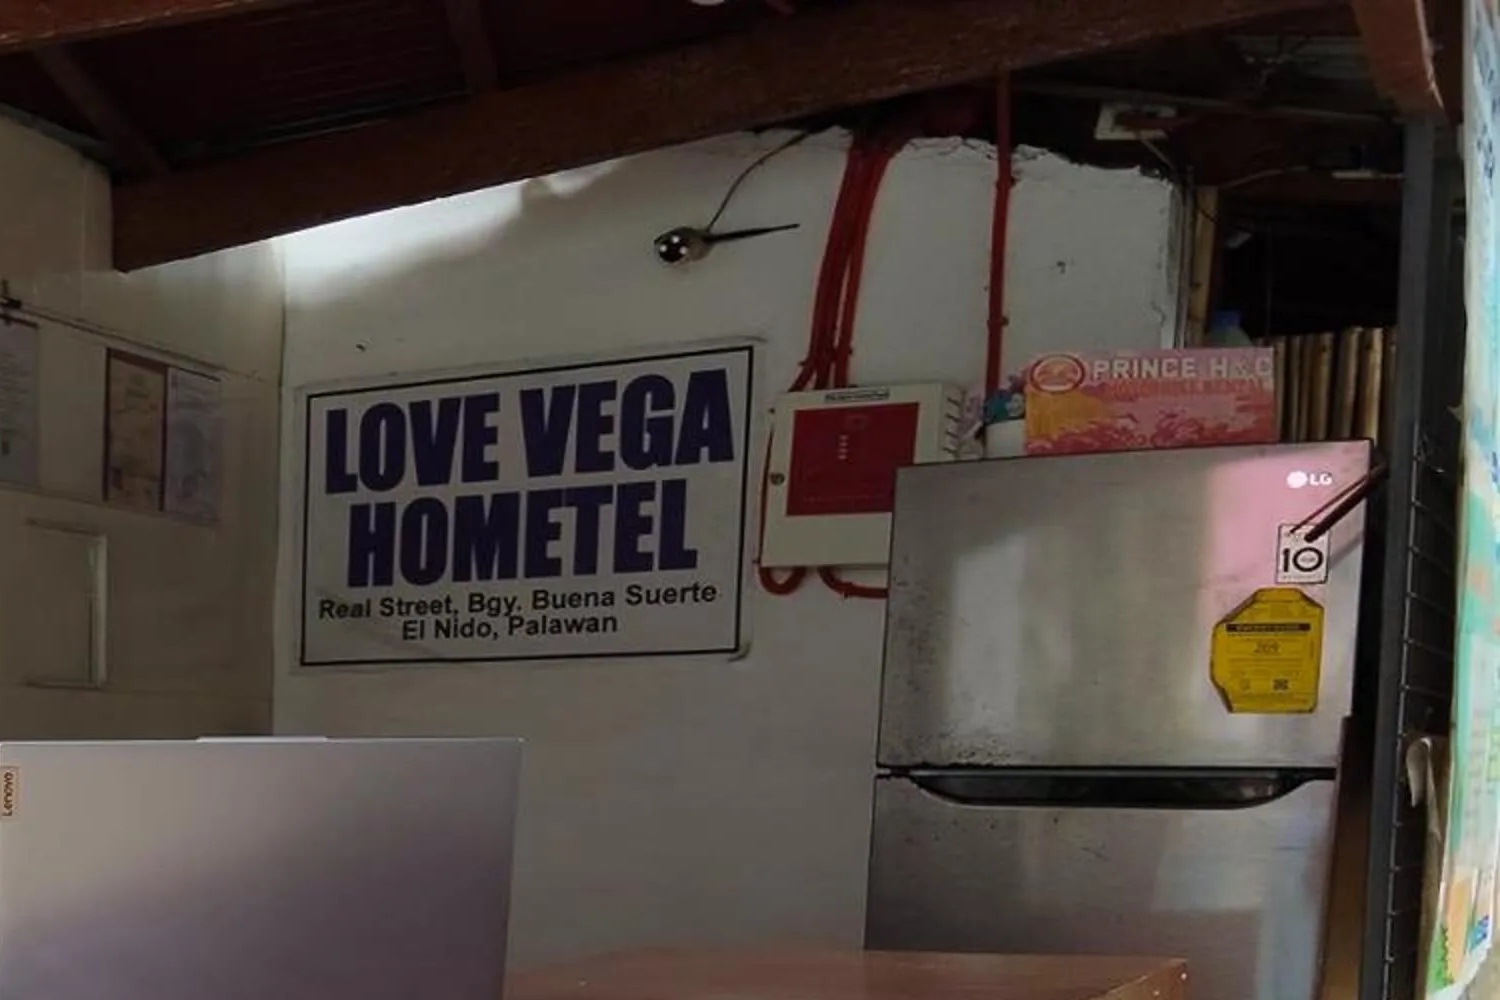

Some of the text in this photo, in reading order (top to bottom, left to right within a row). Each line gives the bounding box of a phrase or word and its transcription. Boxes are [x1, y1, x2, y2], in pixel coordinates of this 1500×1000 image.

[1093, 357, 1197, 380] PRINCE
[325, 368, 735, 495] LOVE VEGA
[1309, 471, 1333, 486] LG
[347, 478, 697, 588] HOMETEL
[1283, 547, 1324, 573] 10
[319, 582, 718, 621] Real Street, Bgy. Buena Suerte
[402, 613, 618, 641] El Nido, Palawan
[2, 771, 14, 817] Lenovo
